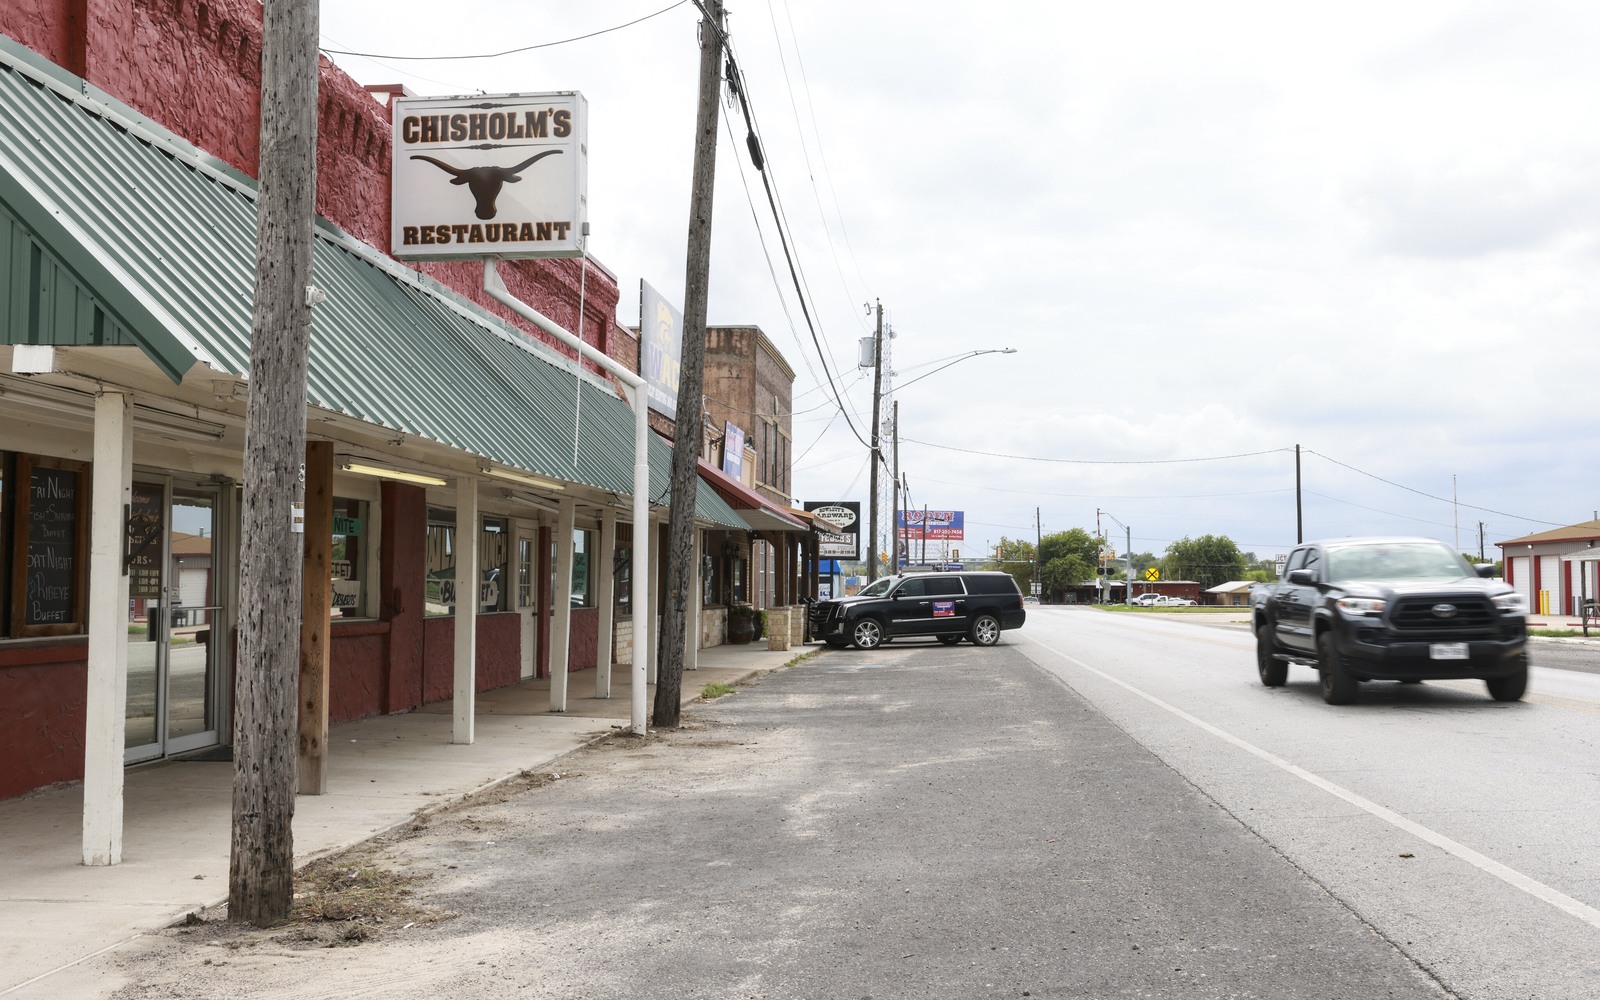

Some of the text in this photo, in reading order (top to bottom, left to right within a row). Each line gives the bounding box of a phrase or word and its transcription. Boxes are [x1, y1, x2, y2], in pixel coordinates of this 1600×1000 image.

[403, 107, 572, 144] CHISHOLM'S
[403, 221, 571, 245] RESTAURANT
[47, 476, 75, 498] NIGHT
[334, 517, 355, 533] NITE
[902, 511, 954, 521] RODEN
[47, 546, 73, 570] NIGHT
[481, 531, 507, 572] UNCH
[35, 571, 70, 600] RIBEYE
[32, 600, 66, 621] BUFFET
